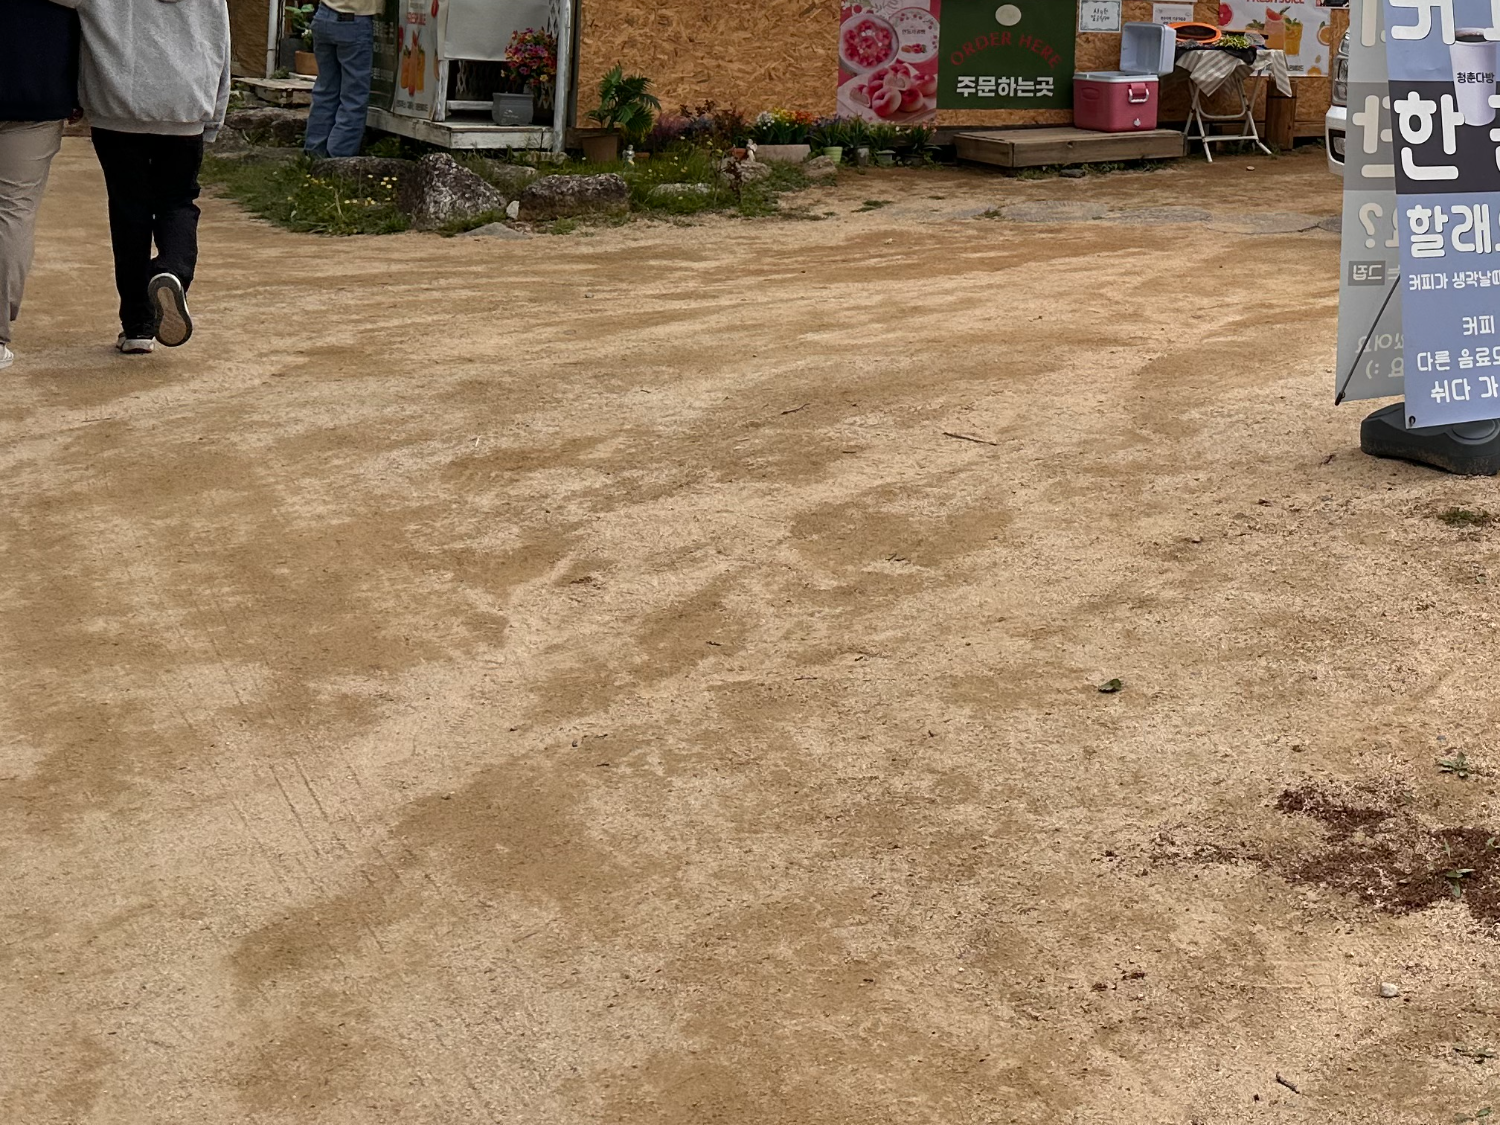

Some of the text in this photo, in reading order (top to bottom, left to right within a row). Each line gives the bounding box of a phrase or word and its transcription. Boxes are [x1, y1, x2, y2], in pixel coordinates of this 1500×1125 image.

[950, 31, 1062, 70] ORDER HERE
[956, 76, 1055, 97] 주문하는곳
[1456, 71, 1495, 84] 청춘다방
[1409, 273, 1448, 291] 커피가
[1462, 315, 1495, 336] 커피
[1416, 350, 1451, 371] 다른
[1430, 377, 1471, 403] 쉬다
